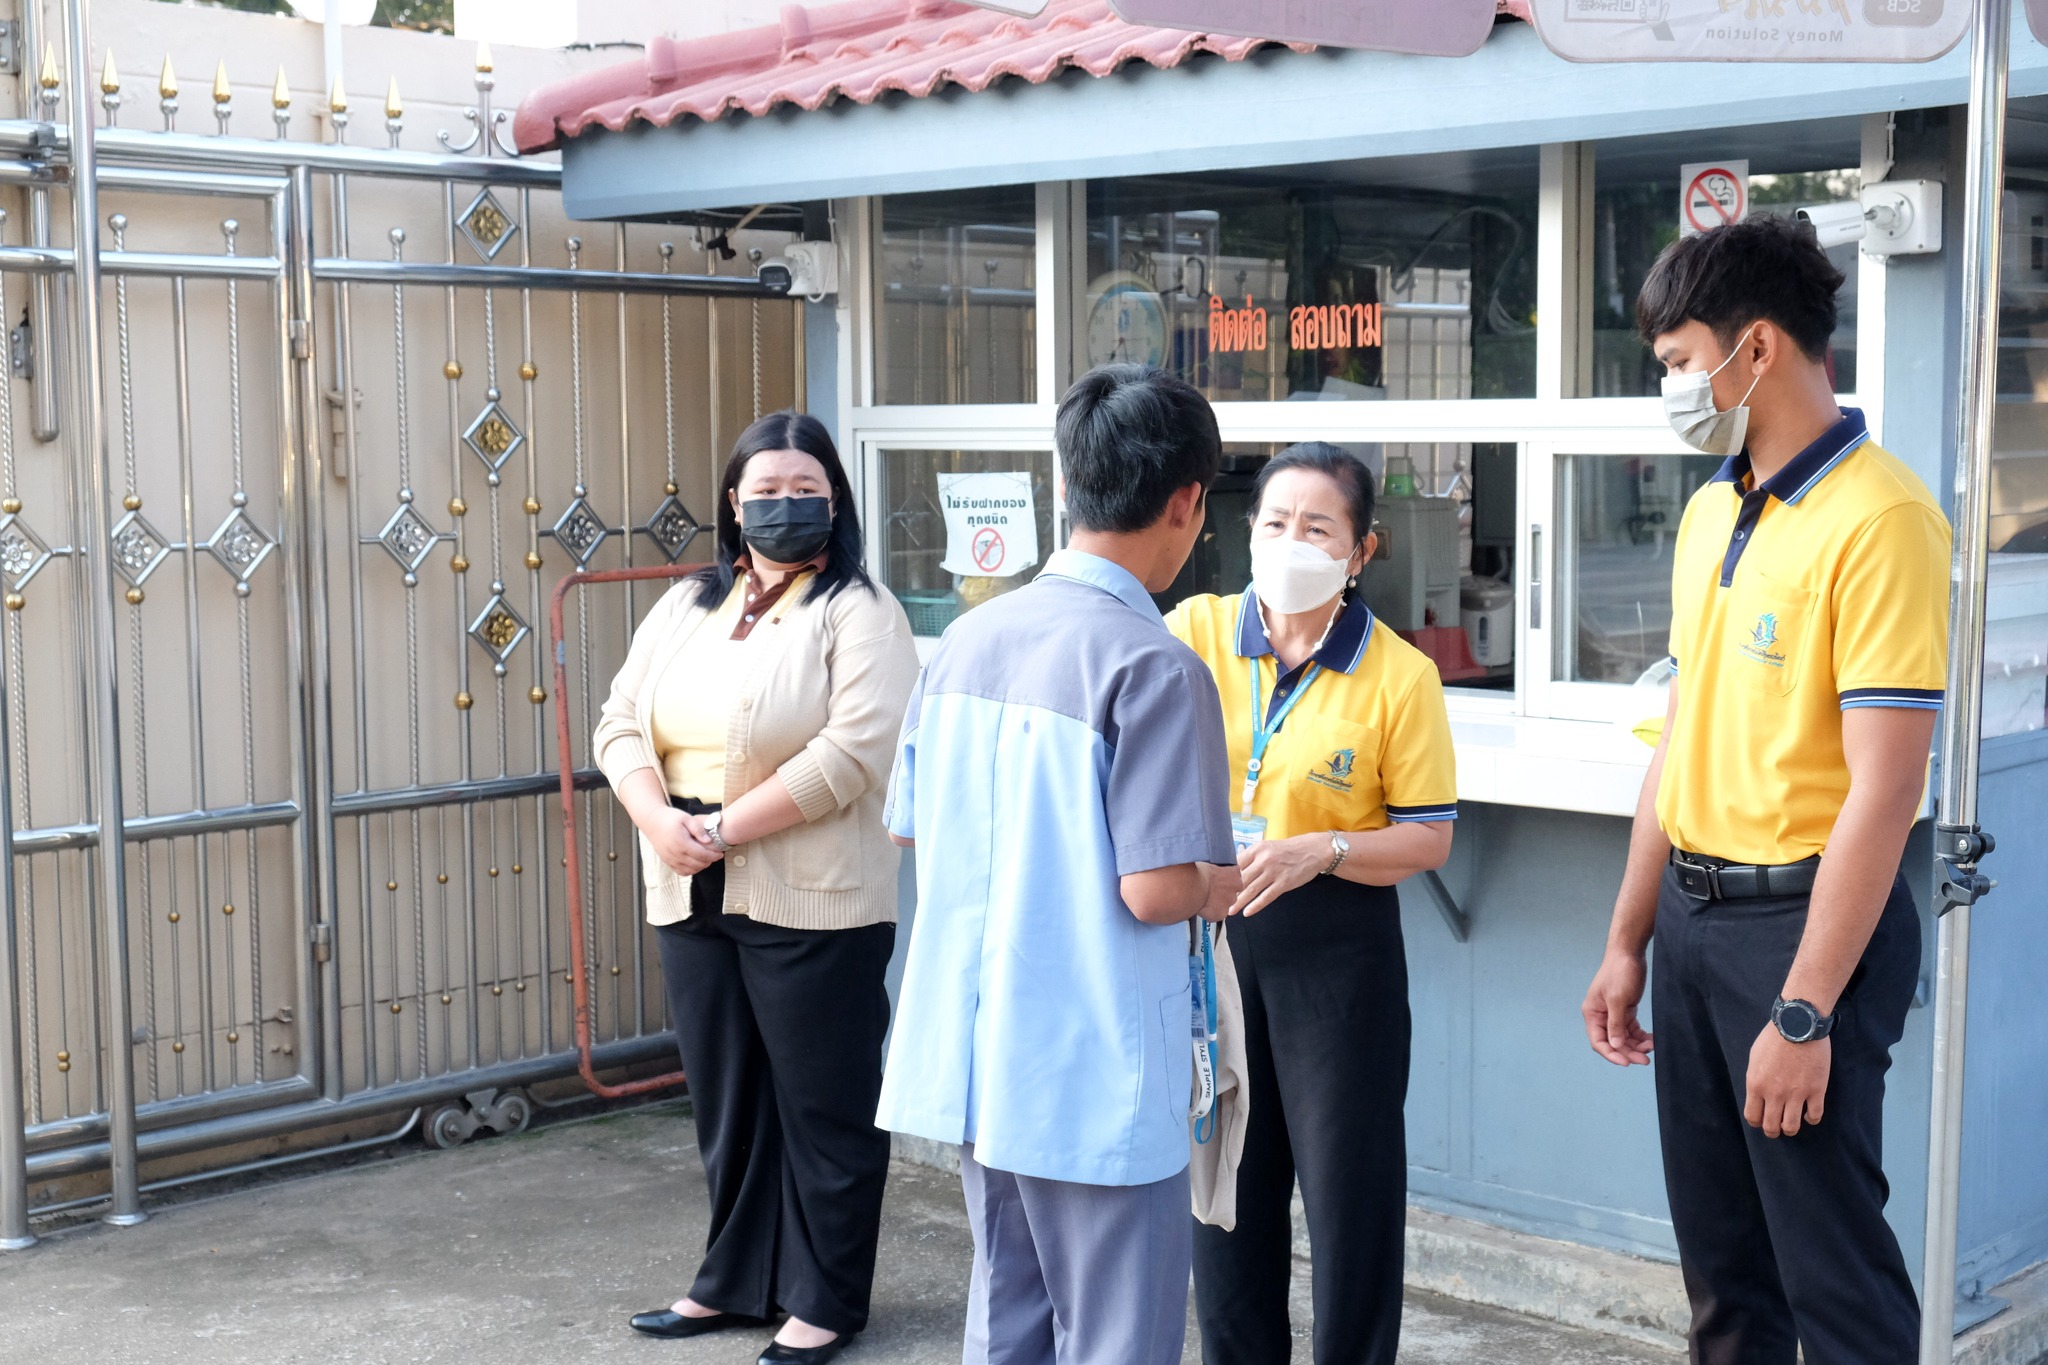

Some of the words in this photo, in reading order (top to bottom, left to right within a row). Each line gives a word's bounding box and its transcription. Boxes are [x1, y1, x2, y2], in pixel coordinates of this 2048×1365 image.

[1209, 294, 1267, 352] ติดต่อ
[1290, 302, 1382, 350] สอบถาม
[946, 494, 1027, 509] ไม่รับฝากของ
[967, 512, 1008, 528] ทุกชนิด
[1203, 1067, 1212, 1098] SIMPLE
